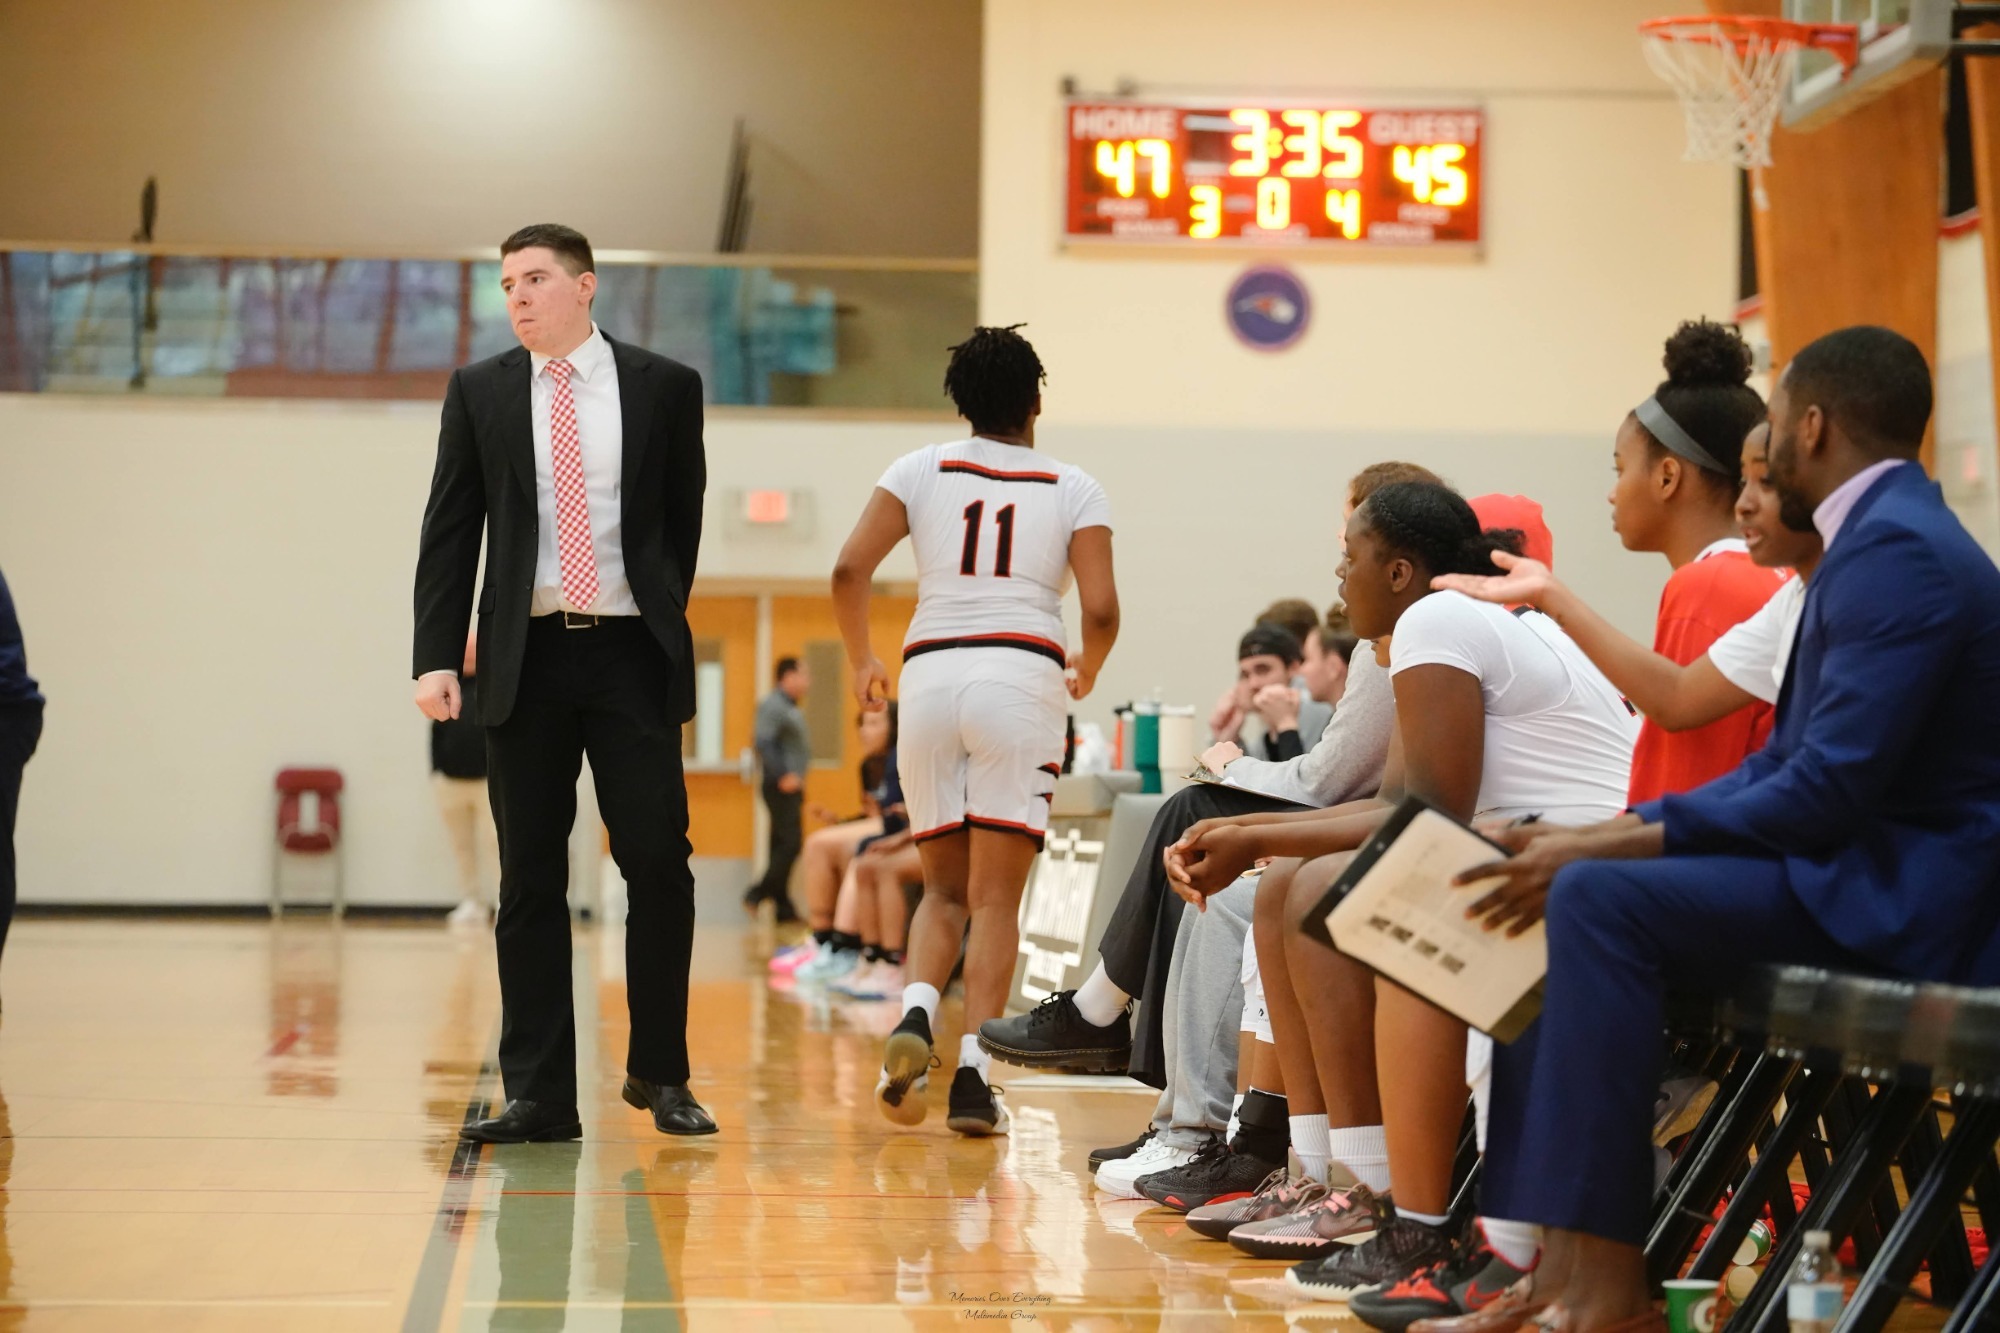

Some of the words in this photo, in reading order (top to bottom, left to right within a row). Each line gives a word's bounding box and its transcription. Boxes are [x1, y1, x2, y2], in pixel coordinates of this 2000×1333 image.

[1073, 108, 1176, 140] HOME
[1229, 108, 1363, 179] 3:35
[1096, 139, 1171, 199] 47
[1393, 144, 1467, 206] 45
[1189, 185, 1222, 239] 3
[1256, 177, 1290, 230] 0
[1325, 189, 1361, 240] 4
[960, 499, 1015, 578] 11
